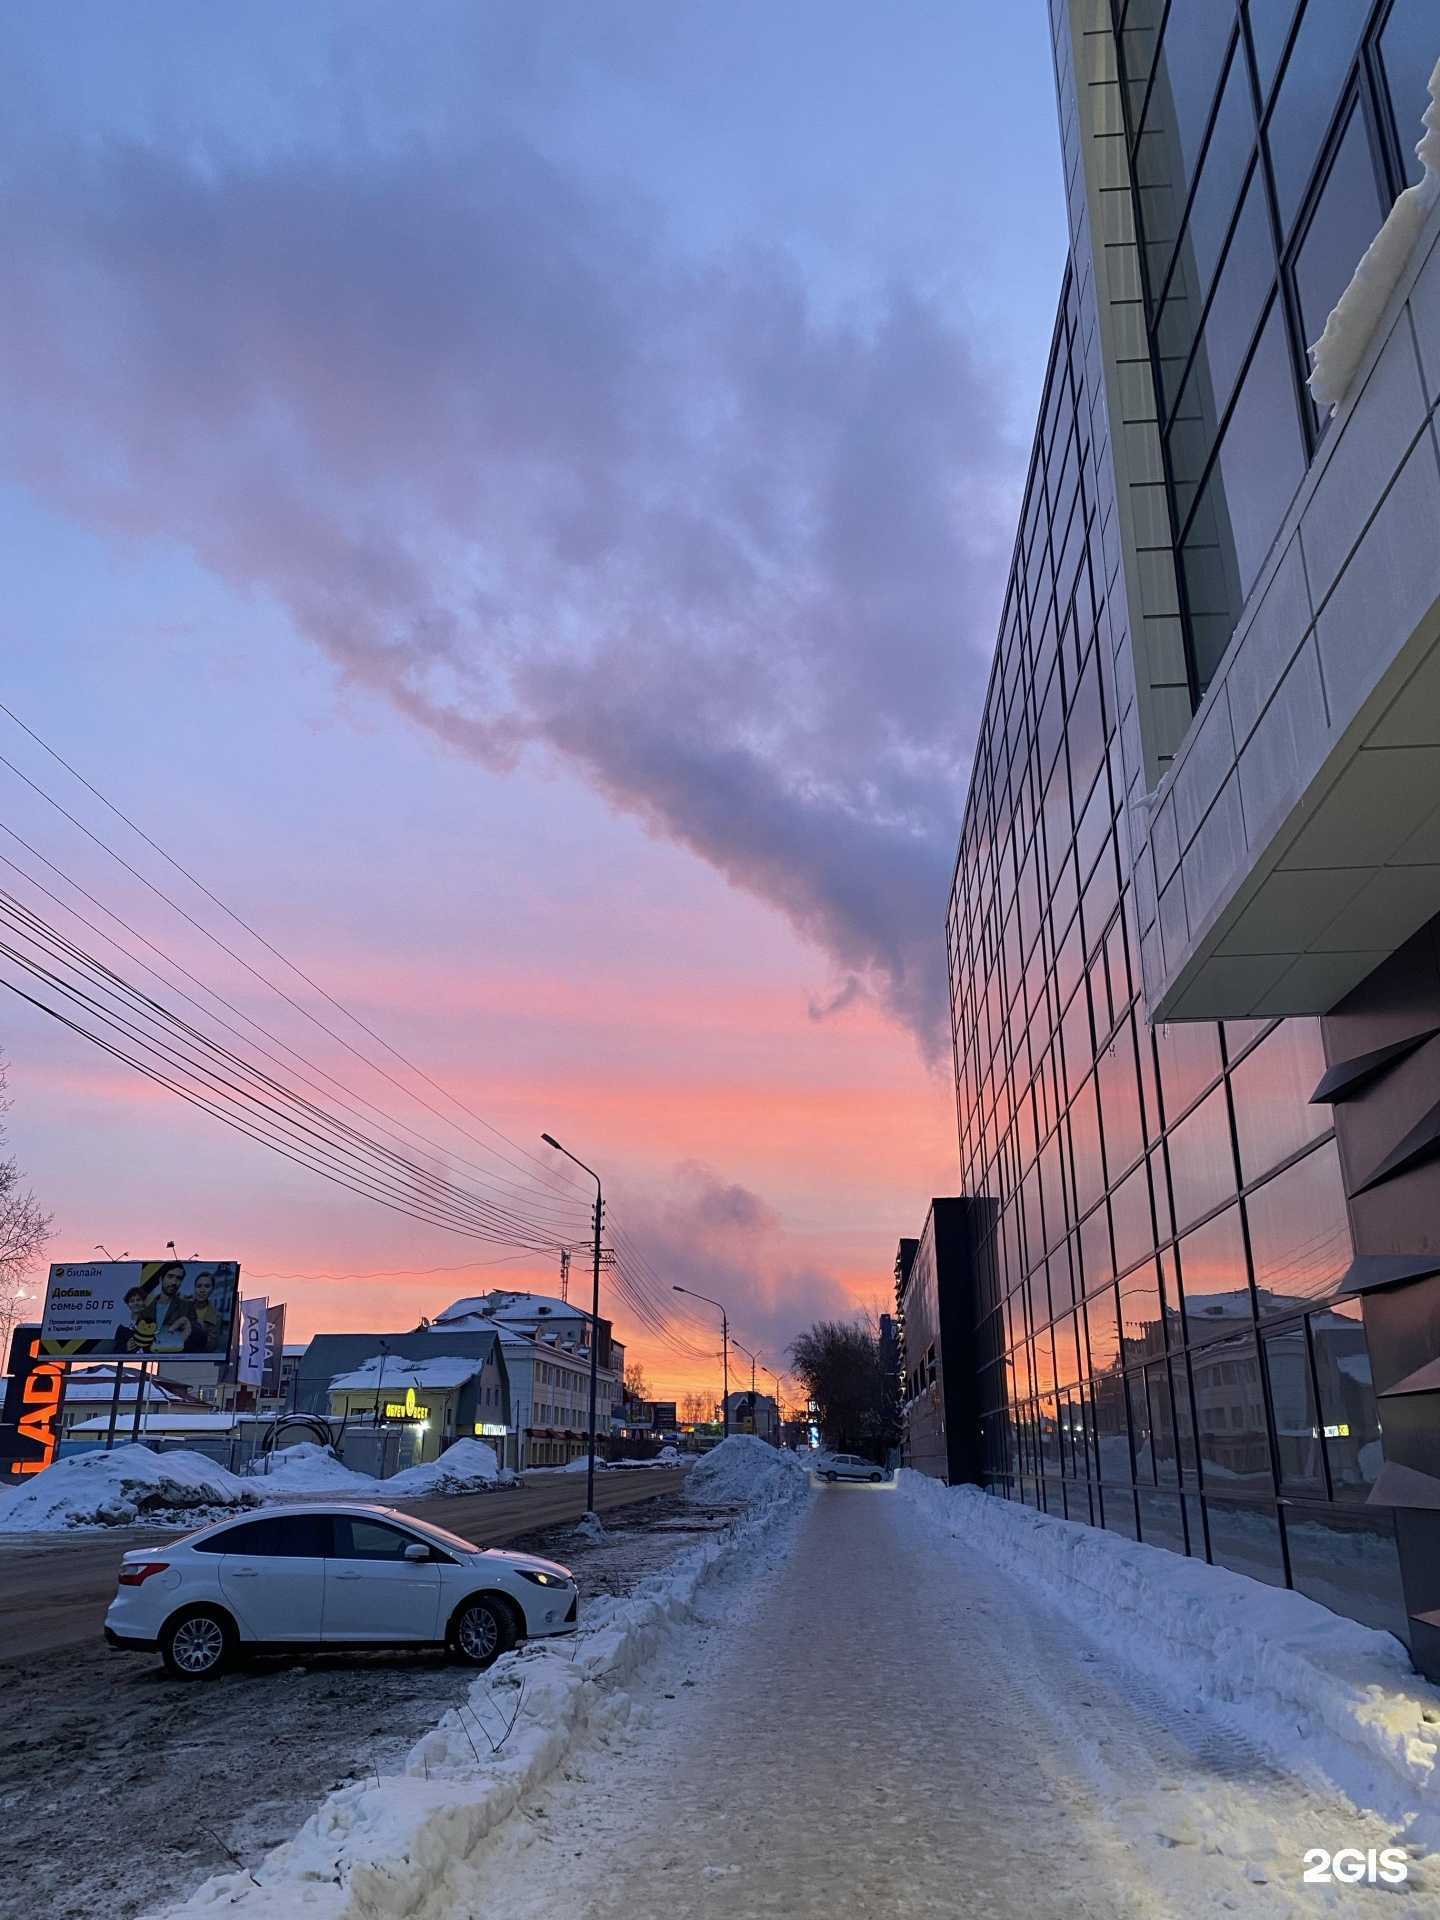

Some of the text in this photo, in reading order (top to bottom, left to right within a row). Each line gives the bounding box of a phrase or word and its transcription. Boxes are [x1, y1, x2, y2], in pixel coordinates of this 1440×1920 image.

[66, 1267, 103, 1277] билайн
[52, 1287, 92, 1299] Добавь
[50, 1300, 115, 1311] семье 50 ГБ
